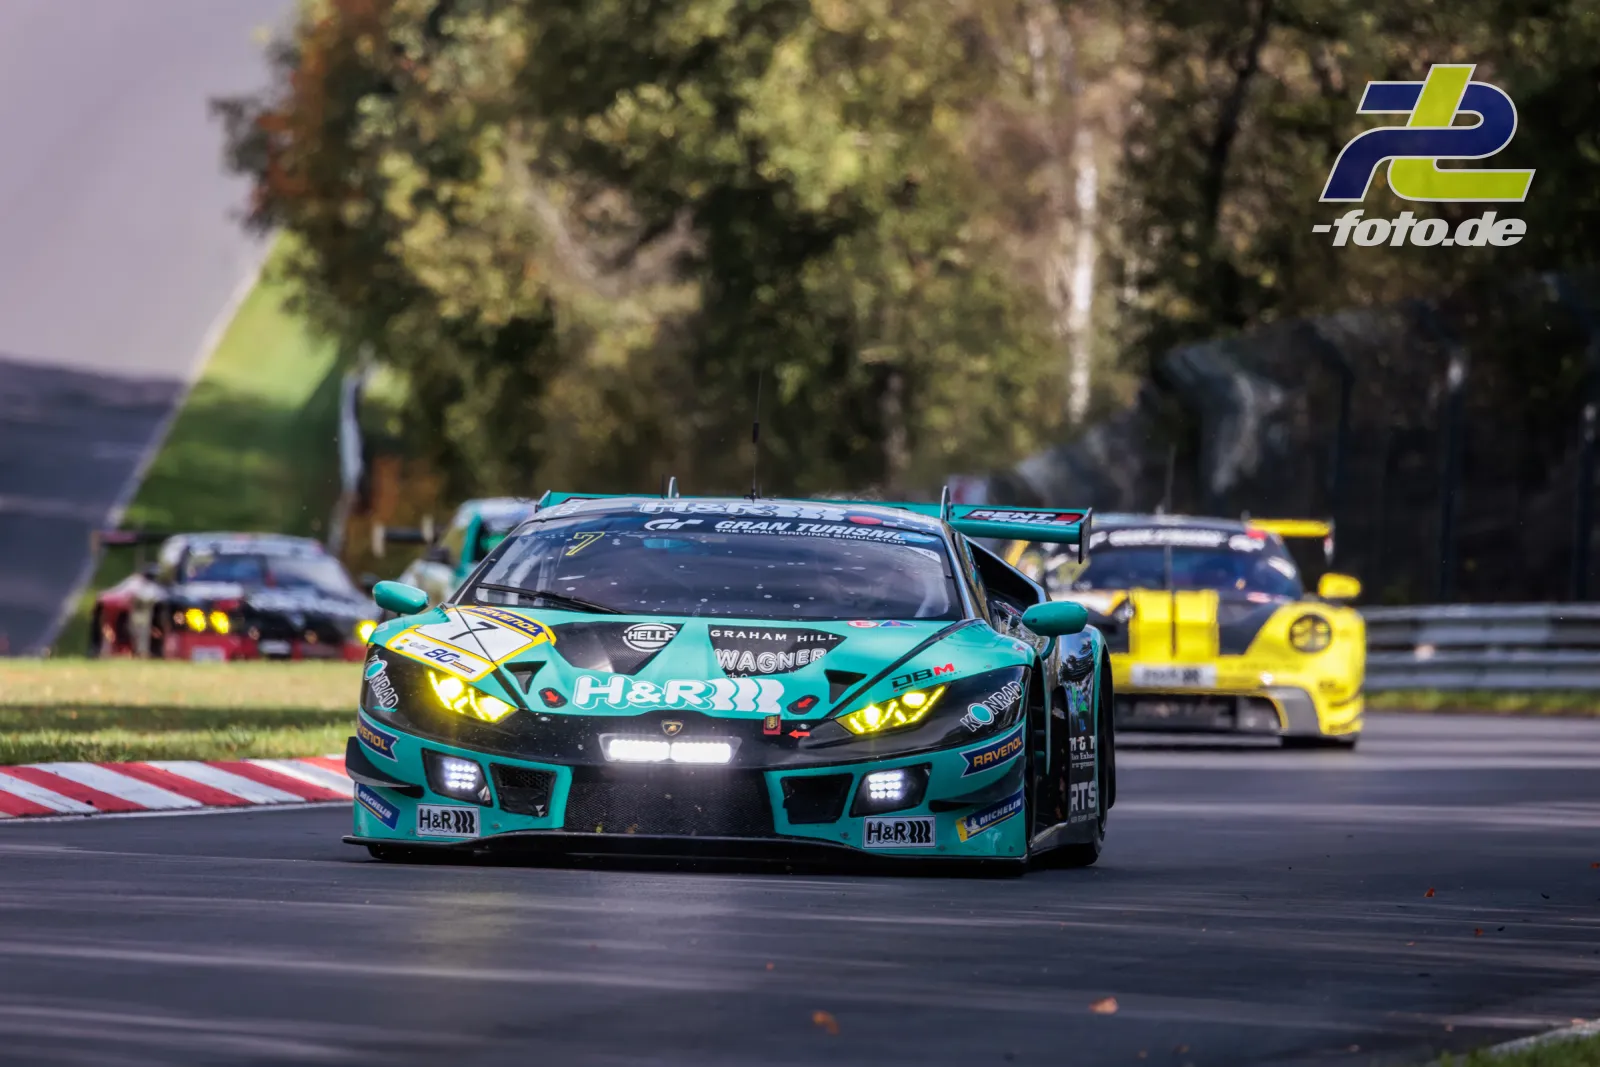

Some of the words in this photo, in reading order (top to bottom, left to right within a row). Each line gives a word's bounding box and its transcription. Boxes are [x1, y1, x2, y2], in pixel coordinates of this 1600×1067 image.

[714, 520, 791, 531] GRAN
[969, 510, 1056, 520] RENT
[565, 531, 605, 556] 7
[833, 534, 907, 545] SIMULATOR
[448, 621, 500, 641] 7
[710, 629, 787, 641] GRAHAM
[797, 633, 838, 643] HILL
[714, 648, 827, 674] WAGNER
[891, 663, 955, 690] DBM
[573, 675, 715, 710] H&R
[960, 681, 1023, 733] KONRAD
[973, 736, 1023, 768] RAVENOL
[359, 791, 392, 819] MICHELIN
[979, 800, 1022, 826] MICHELIN
[419, 808, 452, 829] H&R
[867, 821, 907, 842] H&R
